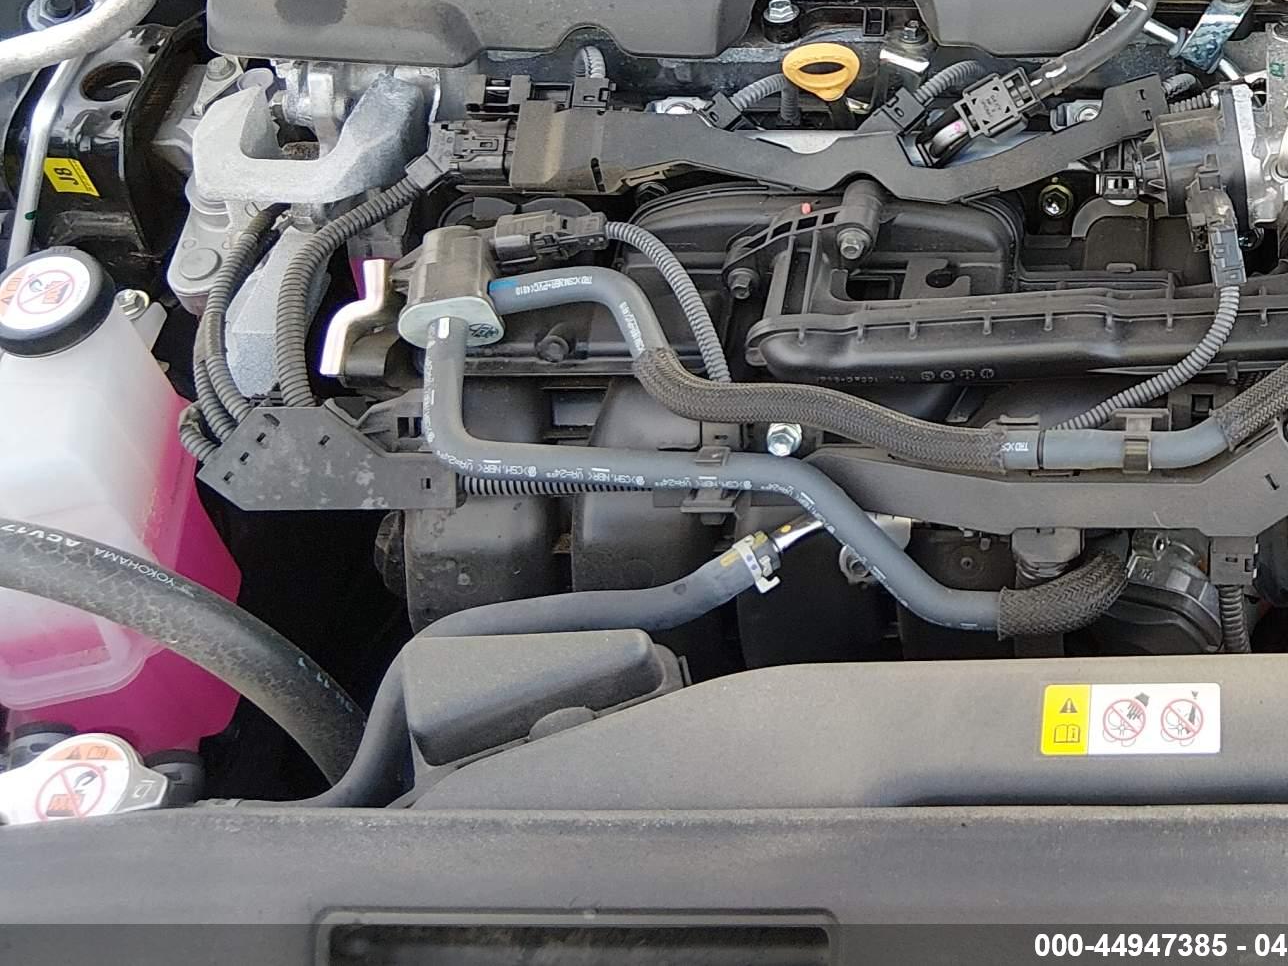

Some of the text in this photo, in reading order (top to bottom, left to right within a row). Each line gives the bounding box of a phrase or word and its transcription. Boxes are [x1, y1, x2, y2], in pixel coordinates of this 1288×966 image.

[54, 167, 79, 186] J8
[1, 523, 176, 589] YOKOHAMA ACV17
